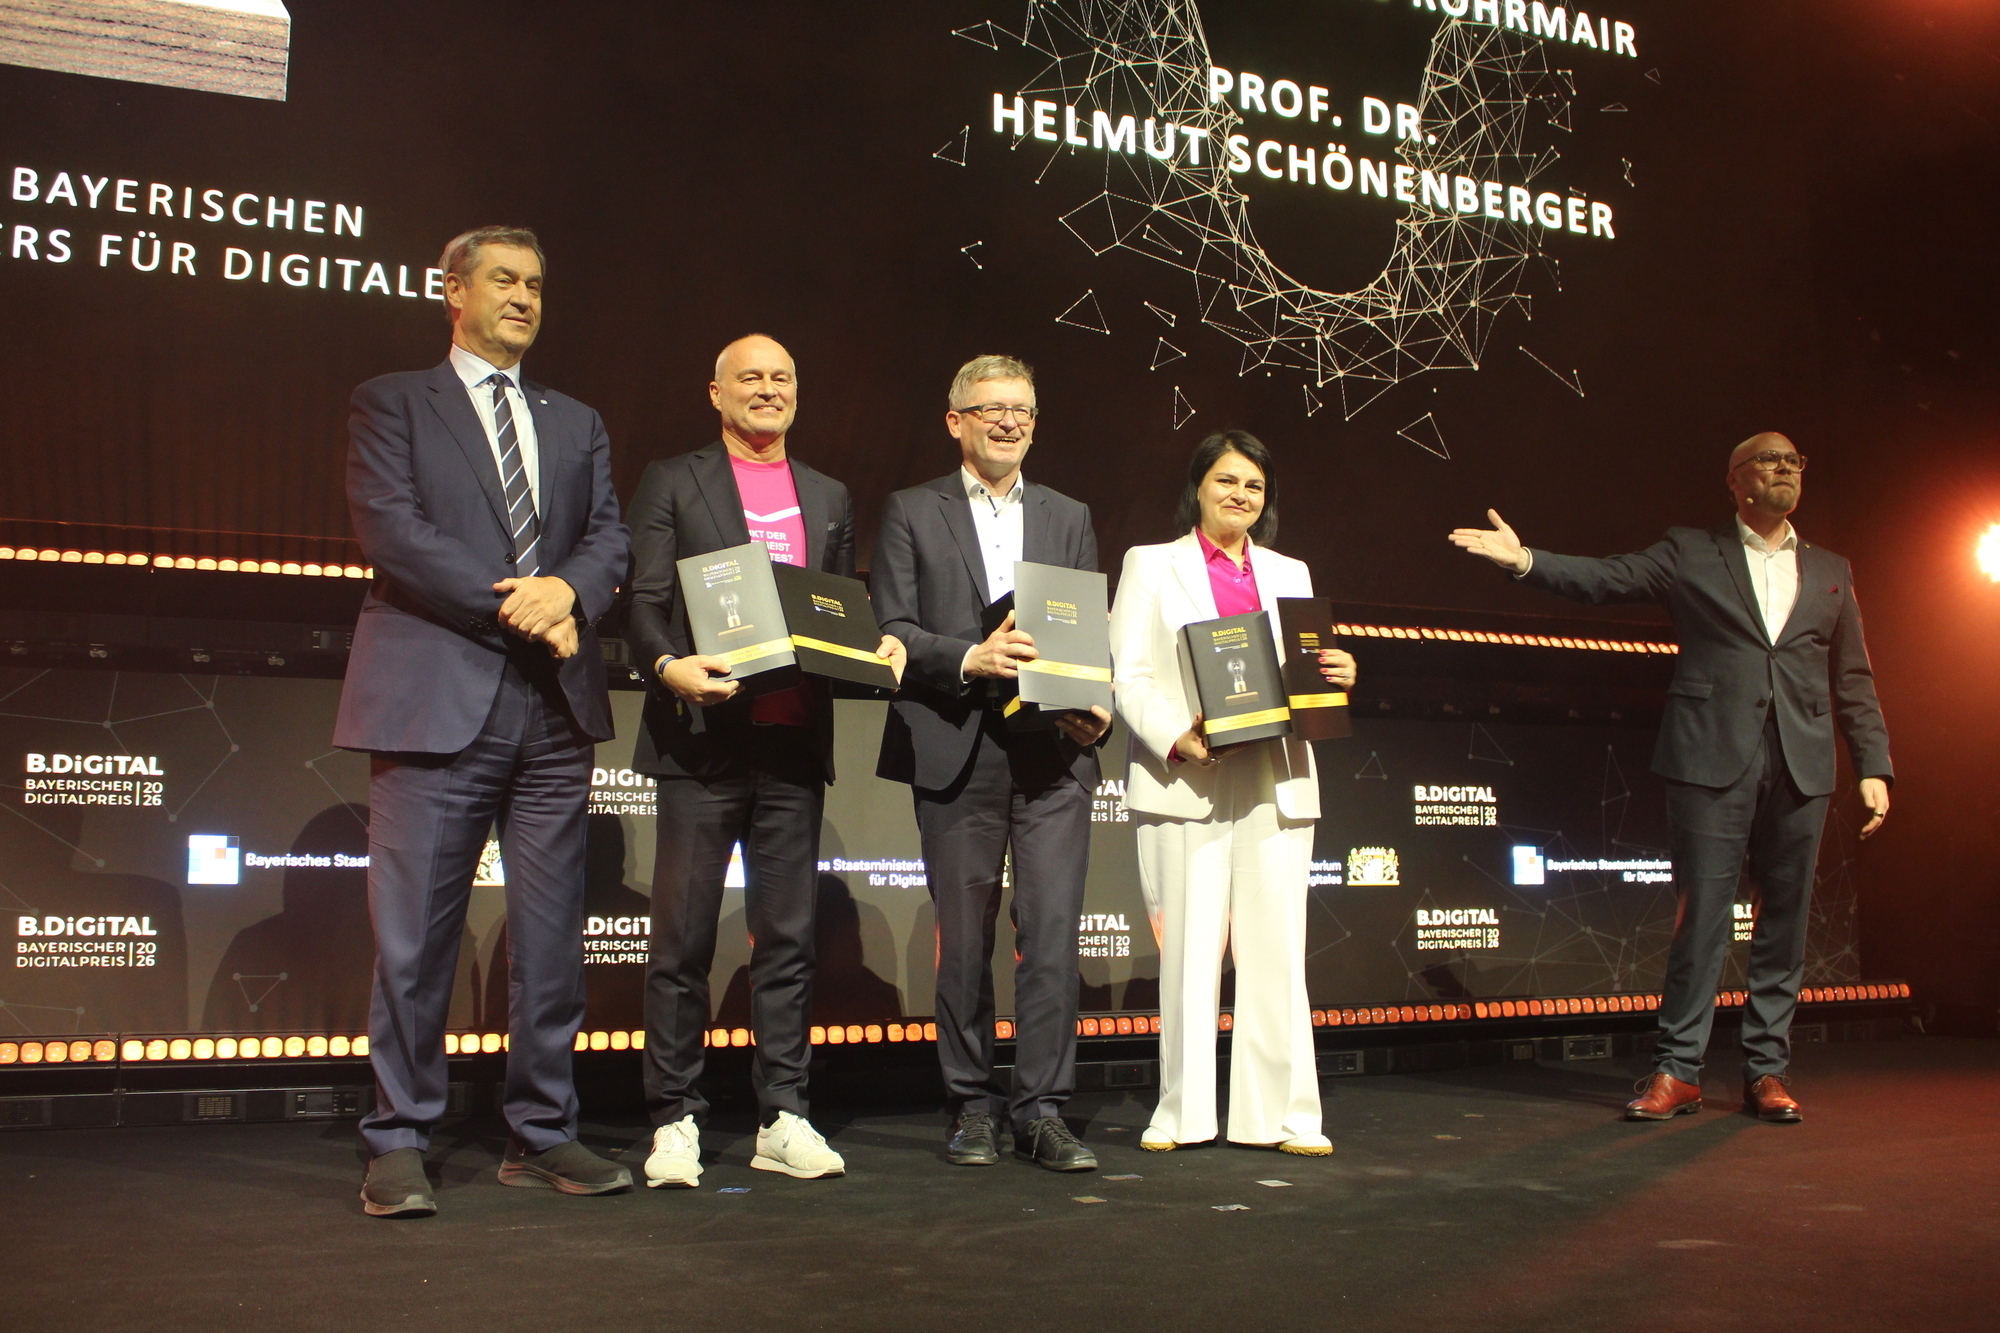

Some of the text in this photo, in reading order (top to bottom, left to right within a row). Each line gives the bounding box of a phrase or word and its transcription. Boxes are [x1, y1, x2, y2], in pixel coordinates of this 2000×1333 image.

[1209, 66, 1437, 146] PROF. DR.
[993, 93, 1615, 239] HELMUT SCHÖNENBERGER
[12, 167, 363, 237] BAYERISCHEN
[0, 223, 72, 263] RS
[99, 231, 197, 276] FÜR
[765, 531, 787, 541] DER
[25, 779, 163, 794] BAYERISCHER 20
[25, 793, 162, 806] DIGITALPREIS 26
[1415, 805, 1497, 816] BAYERISCHER 20
[1115, 812, 1129, 822] 26
[1415, 816, 1497, 826] DIGITALPREIS 26
[246, 852, 331, 869] Bayerisches
[1547, 859, 1672, 872] Bayerisches Staatsministerium
[869, 873, 887, 886] für
[1623, 871, 1672, 884] für Digitales
[1417, 928, 1500, 939] BAYERISCHER 20
[1115, 935, 1130, 946] 20
[1417, 938, 1500, 950] DIGITALPREIS 26
[17, 942, 157, 954] BAYERISCHER 20
[1115, 946, 1130, 957] 26
[16, 955, 155, 967] DIGITALPREIS 26
